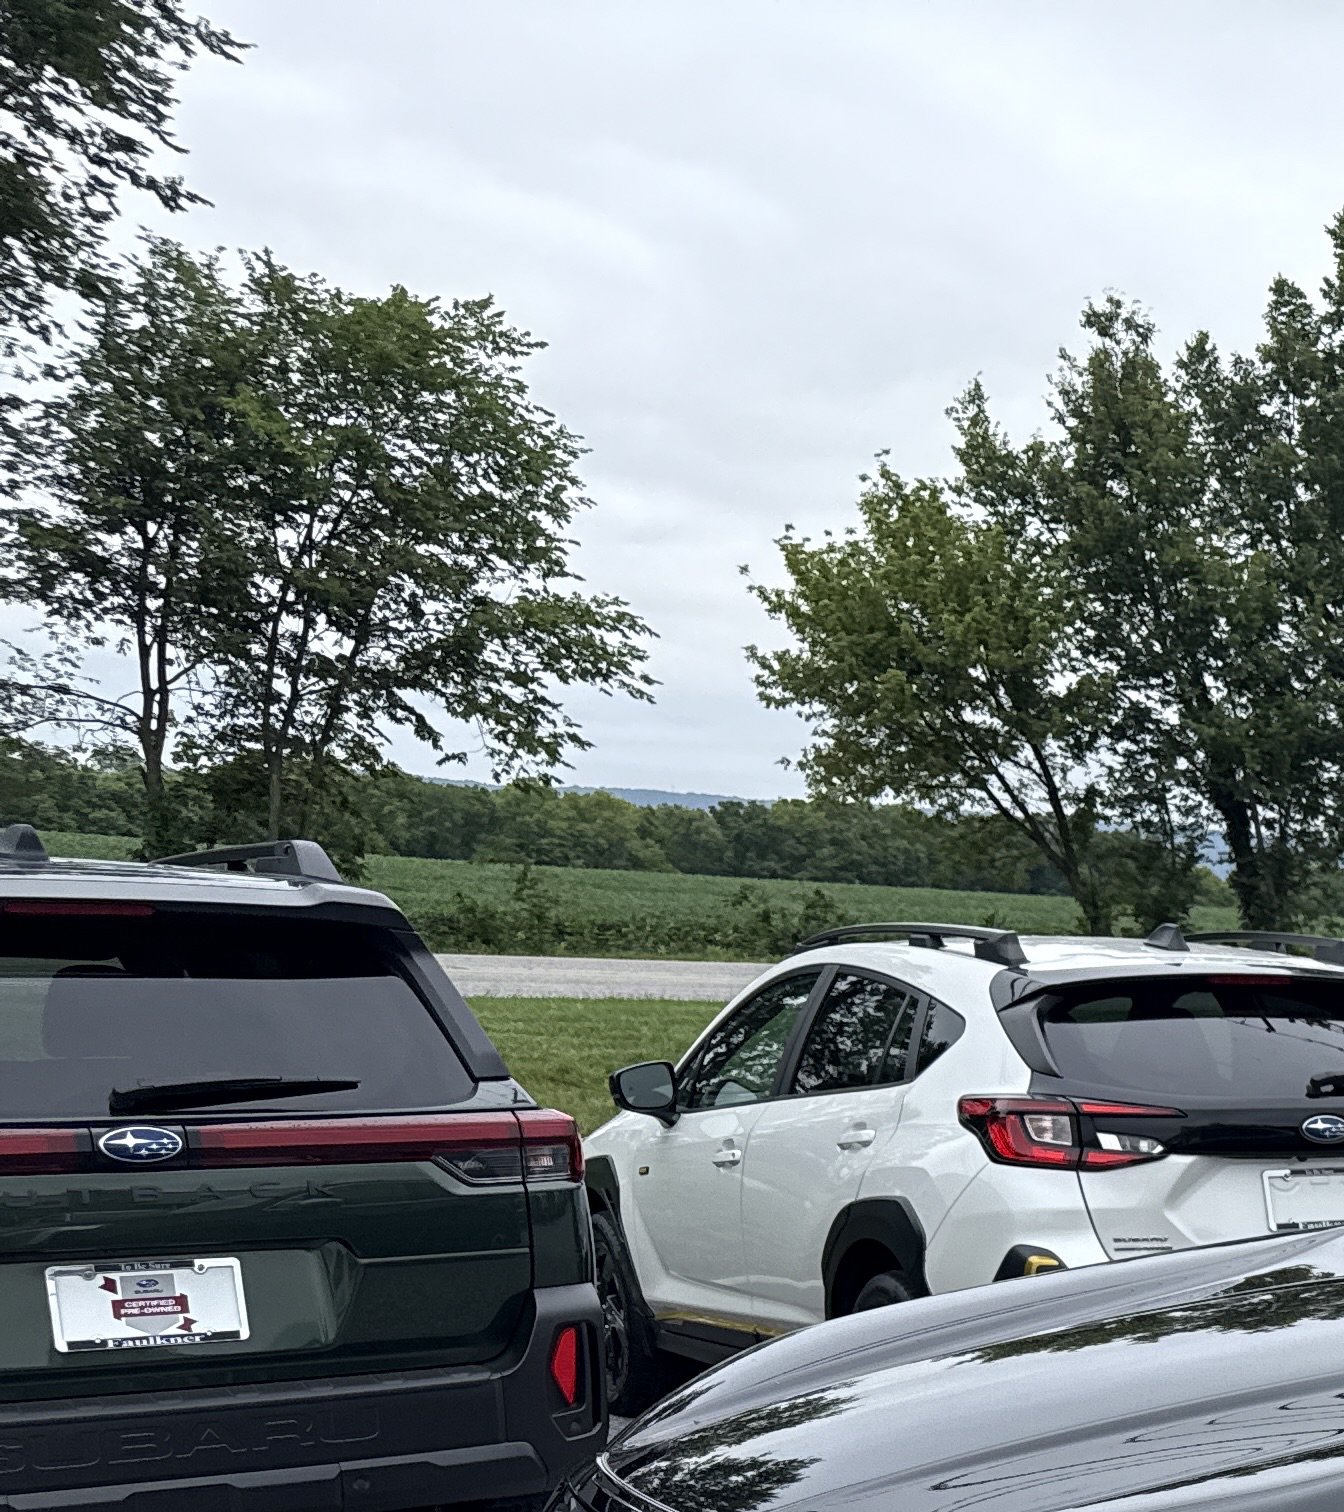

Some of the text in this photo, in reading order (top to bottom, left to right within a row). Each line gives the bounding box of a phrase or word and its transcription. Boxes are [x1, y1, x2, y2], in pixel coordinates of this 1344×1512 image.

[124, 1299, 176, 1308] CERTIFIED
[120, 1306, 181, 1315] PRE-OWNED
[107, 1333, 206, 1349] Faulkner
